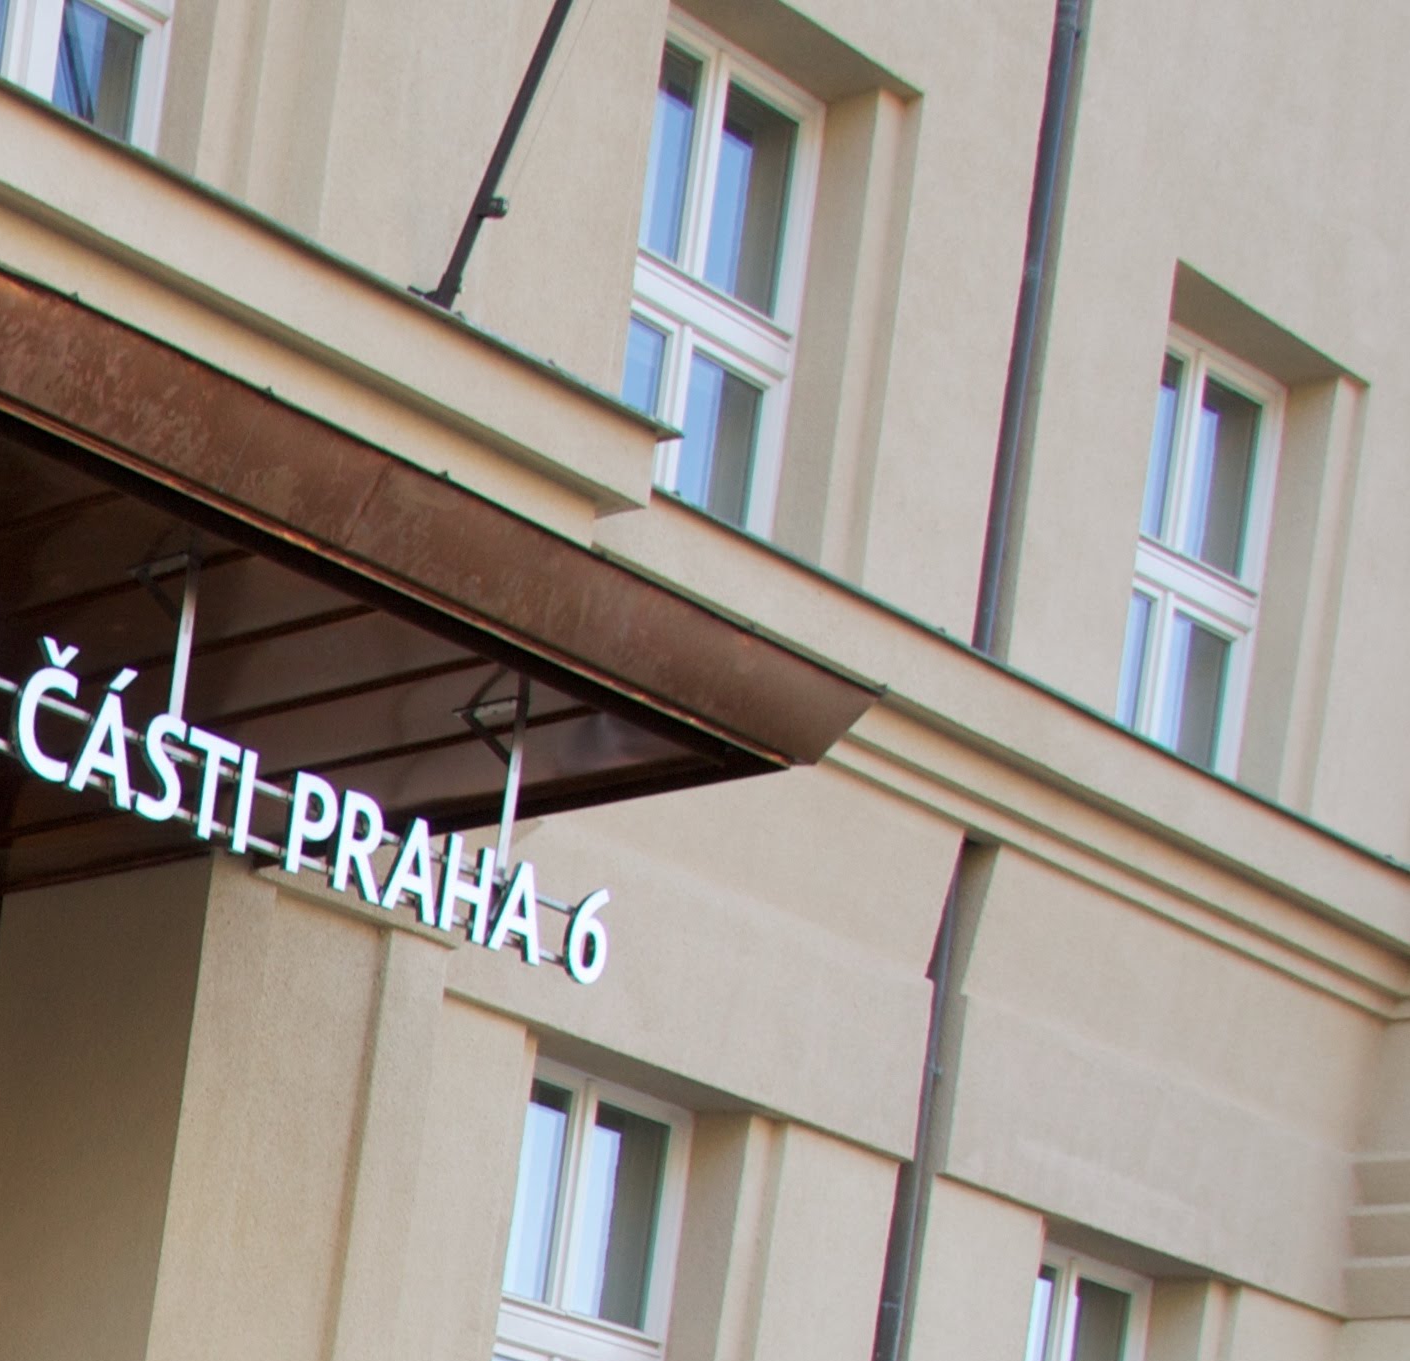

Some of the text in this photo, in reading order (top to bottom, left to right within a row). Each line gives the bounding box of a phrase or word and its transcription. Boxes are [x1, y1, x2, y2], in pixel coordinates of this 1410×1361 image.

[15, 635, 259, 854] ČÁSTI
[283, 770, 541, 967] PRAHA
[564, 887, 610, 985] 6
